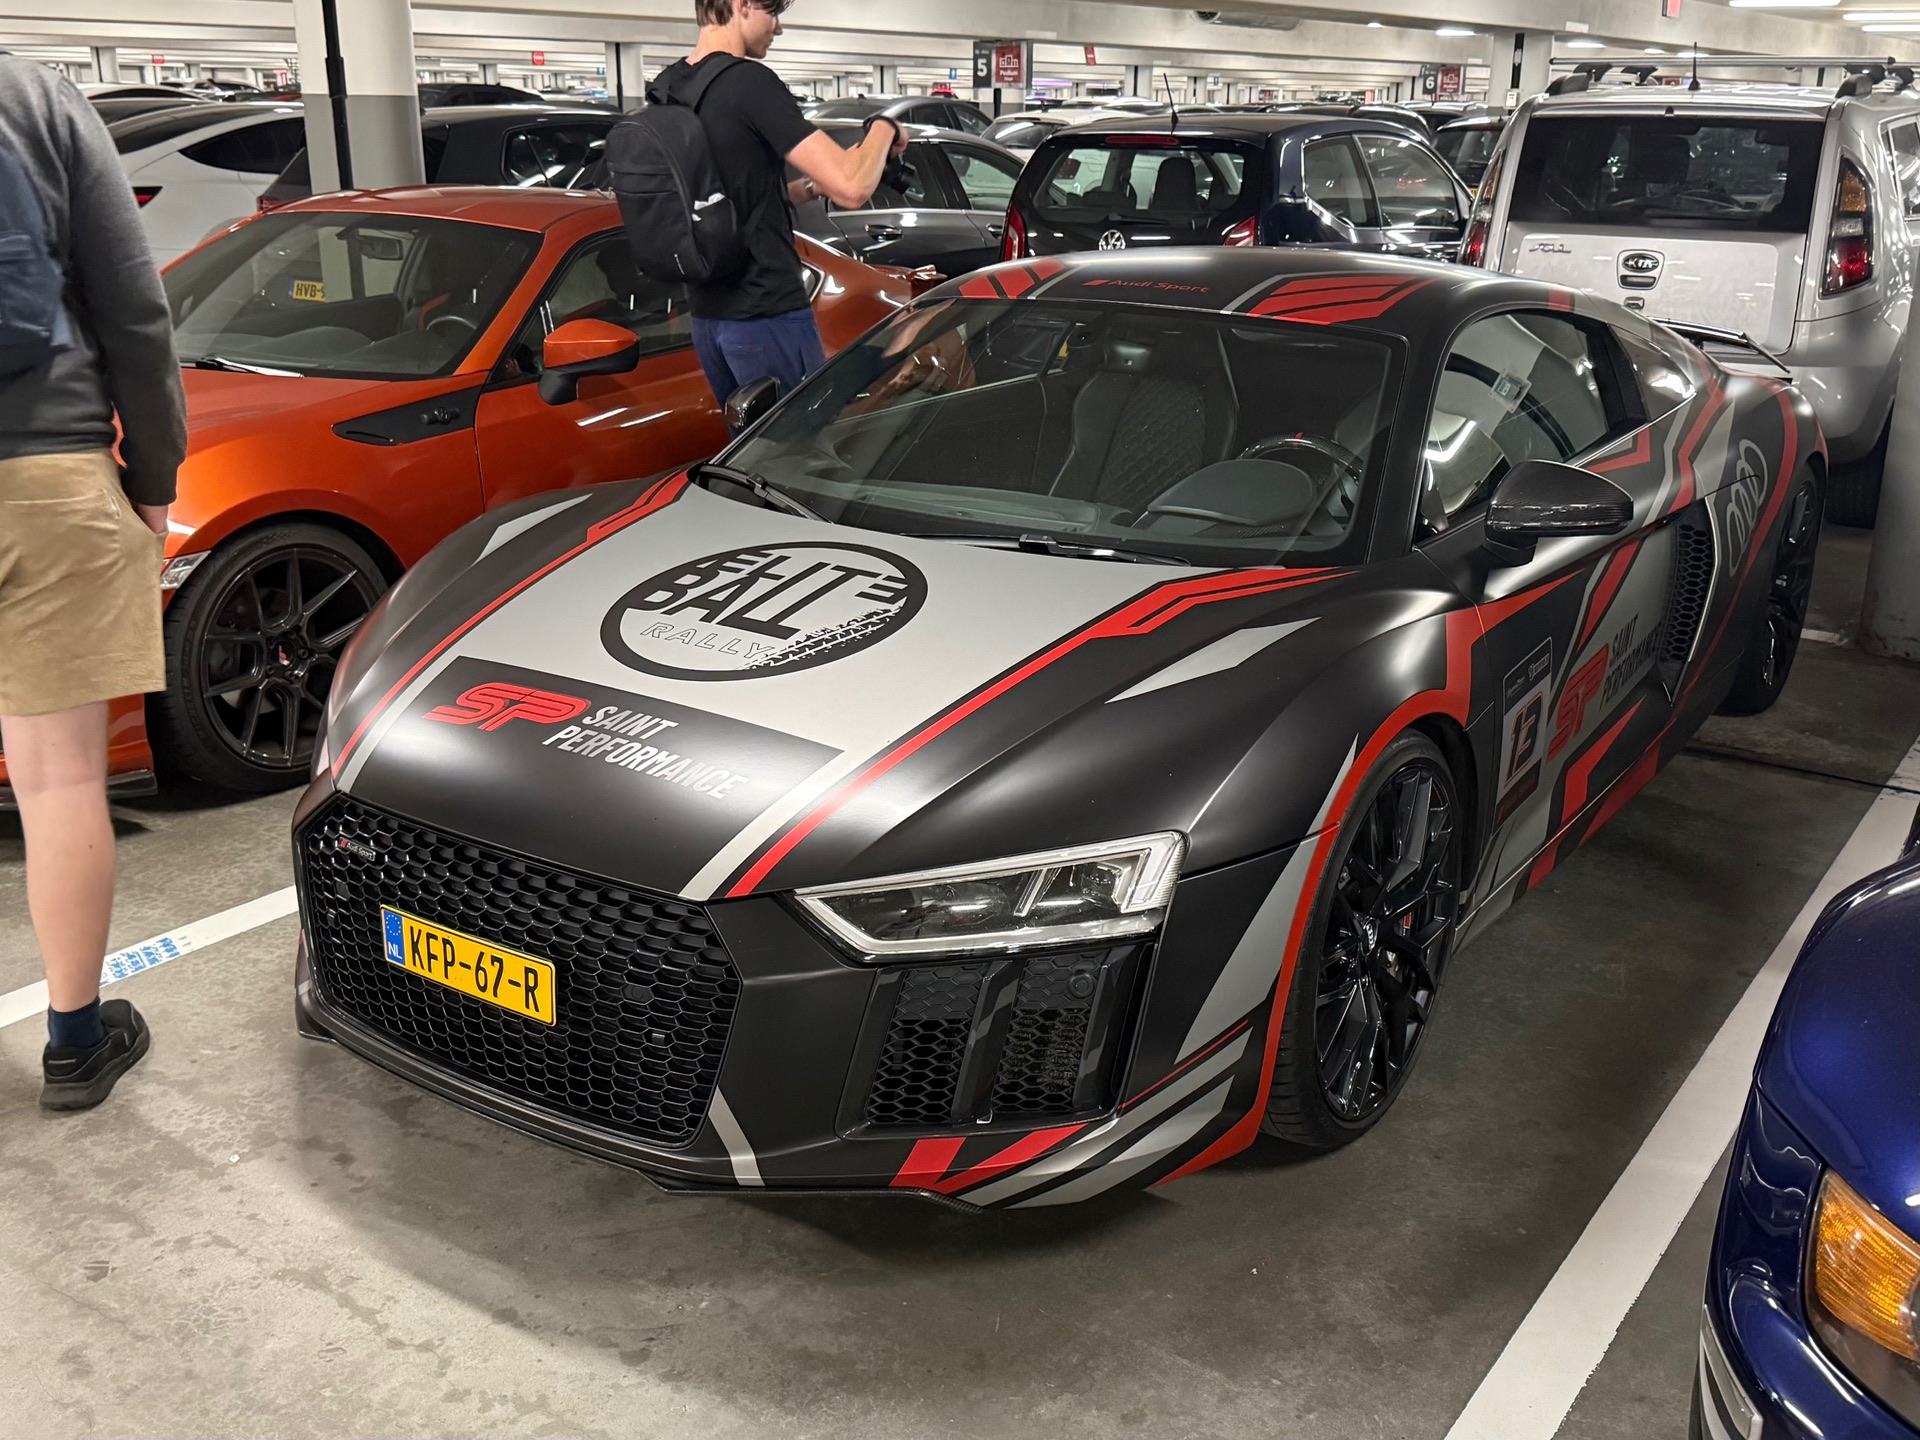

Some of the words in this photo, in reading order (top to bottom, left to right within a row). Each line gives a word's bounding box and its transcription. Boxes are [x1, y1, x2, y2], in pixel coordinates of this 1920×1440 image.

[977, 58, 988, 77] 5
[1425, 76, 1435, 89] 6
[1107, 279, 1153, 288] Audi
[1154, 282, 1210, 293] Sport
[640, 621, 776, 659] RALLY
[421, 682, 592, 732] SP
[582, 705, 680, 740] SAINT
[542, 725, 750, 800] PERFORMANCE
[387, 941, 404, 960] NL
[409, 925, 541, 1013] KFP-67-R
